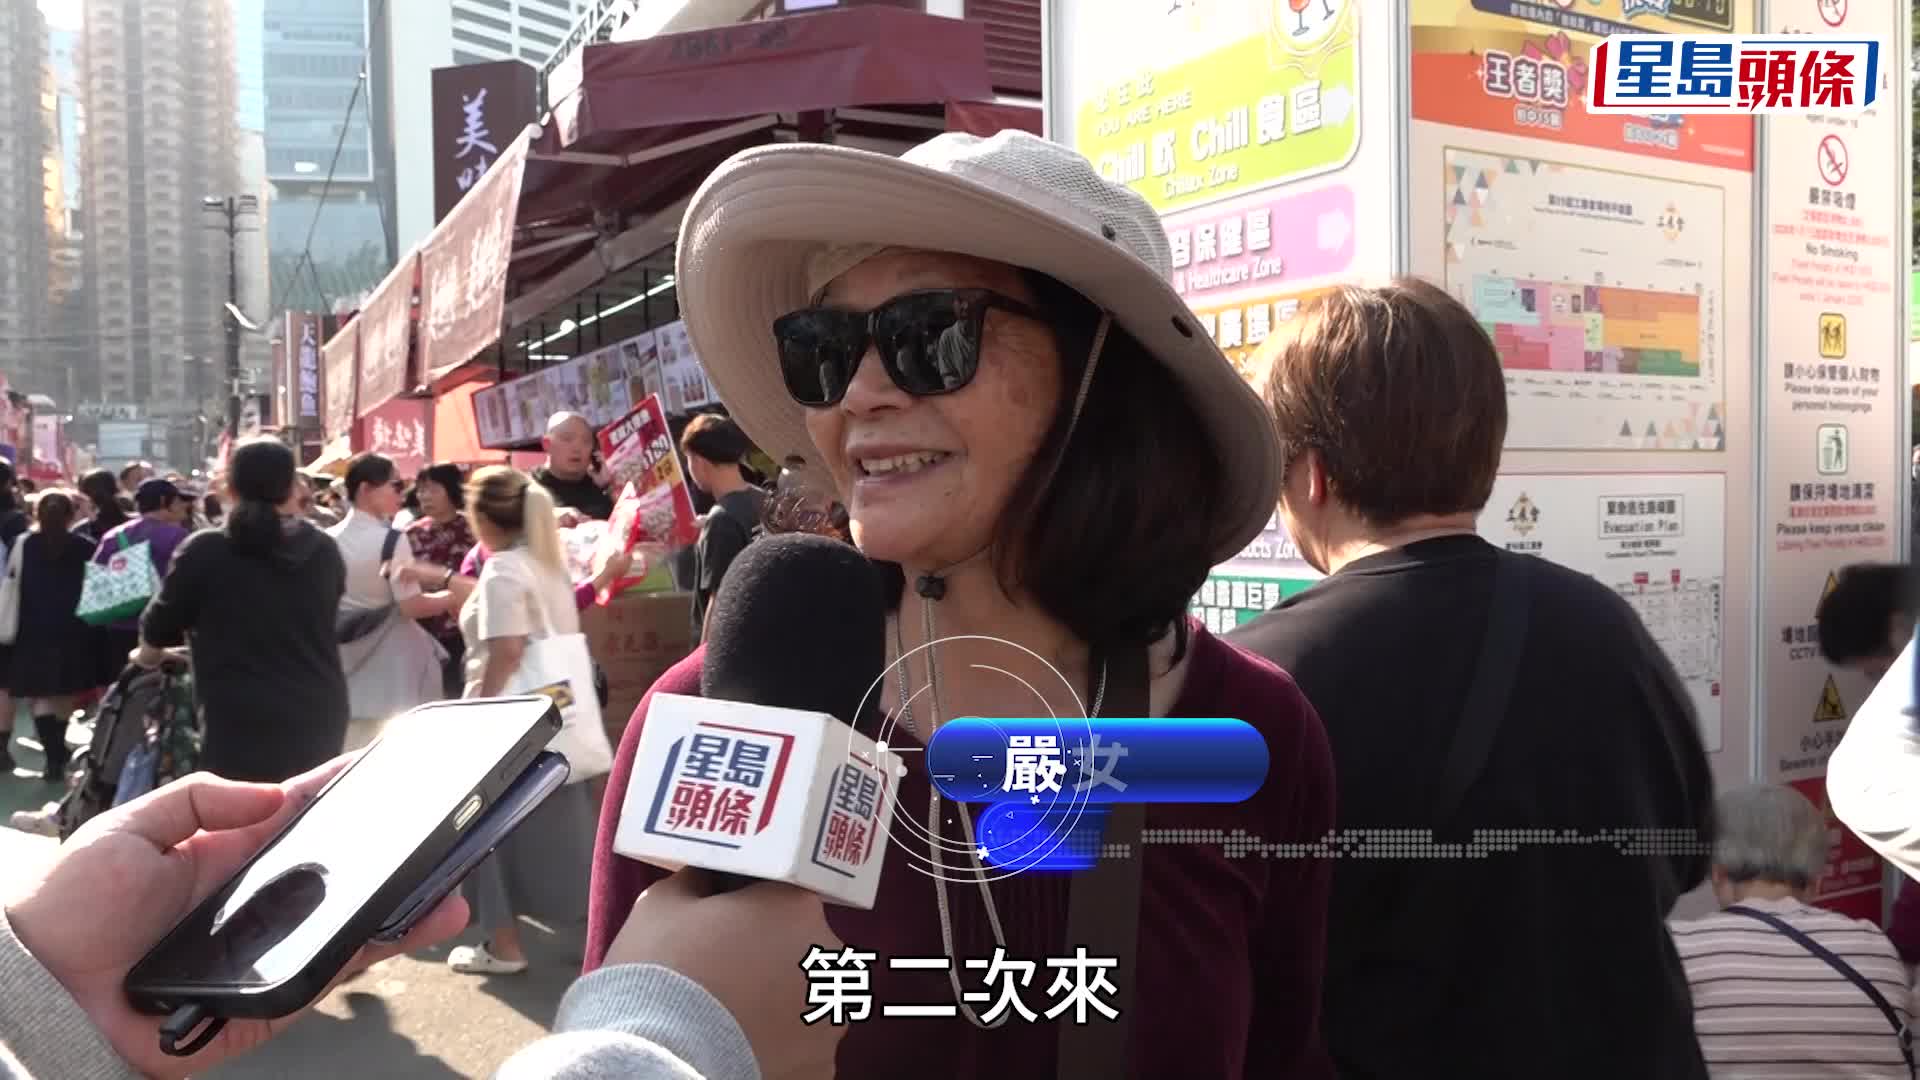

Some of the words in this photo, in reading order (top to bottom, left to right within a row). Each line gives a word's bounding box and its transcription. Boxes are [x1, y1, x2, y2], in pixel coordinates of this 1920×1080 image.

[1485, 52, 1567, 106] 王者獎
[1126, 104, 1153, 127] ARE
[1156, 90, 1192, 117] HERE
[1191, 107, 1249, 161] Chill
[1208, 164, 1239, 189] Zone
[1806, 242, 1819, 255] No
[1820, 244, 1859, 263] Smoking
[1189, 262, 1249, 290] Healthcare
[1252, 255, 1282, 280] Zone
[1784, 383, 1811, 394] Please
[1813, 383, 1830, 395] take
[1832, 385, 1849, 395] care
[1852, 384, 1861, 395] of
[1603, 520, 1655, 534] Evacuation
[1658, 518, 1679, 532] Plan
[1777, 523, 1807, 535] Please
[1809, 523, 1831, 535] keep
[682, 734, 770, 788] 星島
[666, 781, 755, 836] 頭條
[835, 763, 877, 821] 星島
[822, 809, 867, 866] 頭條
